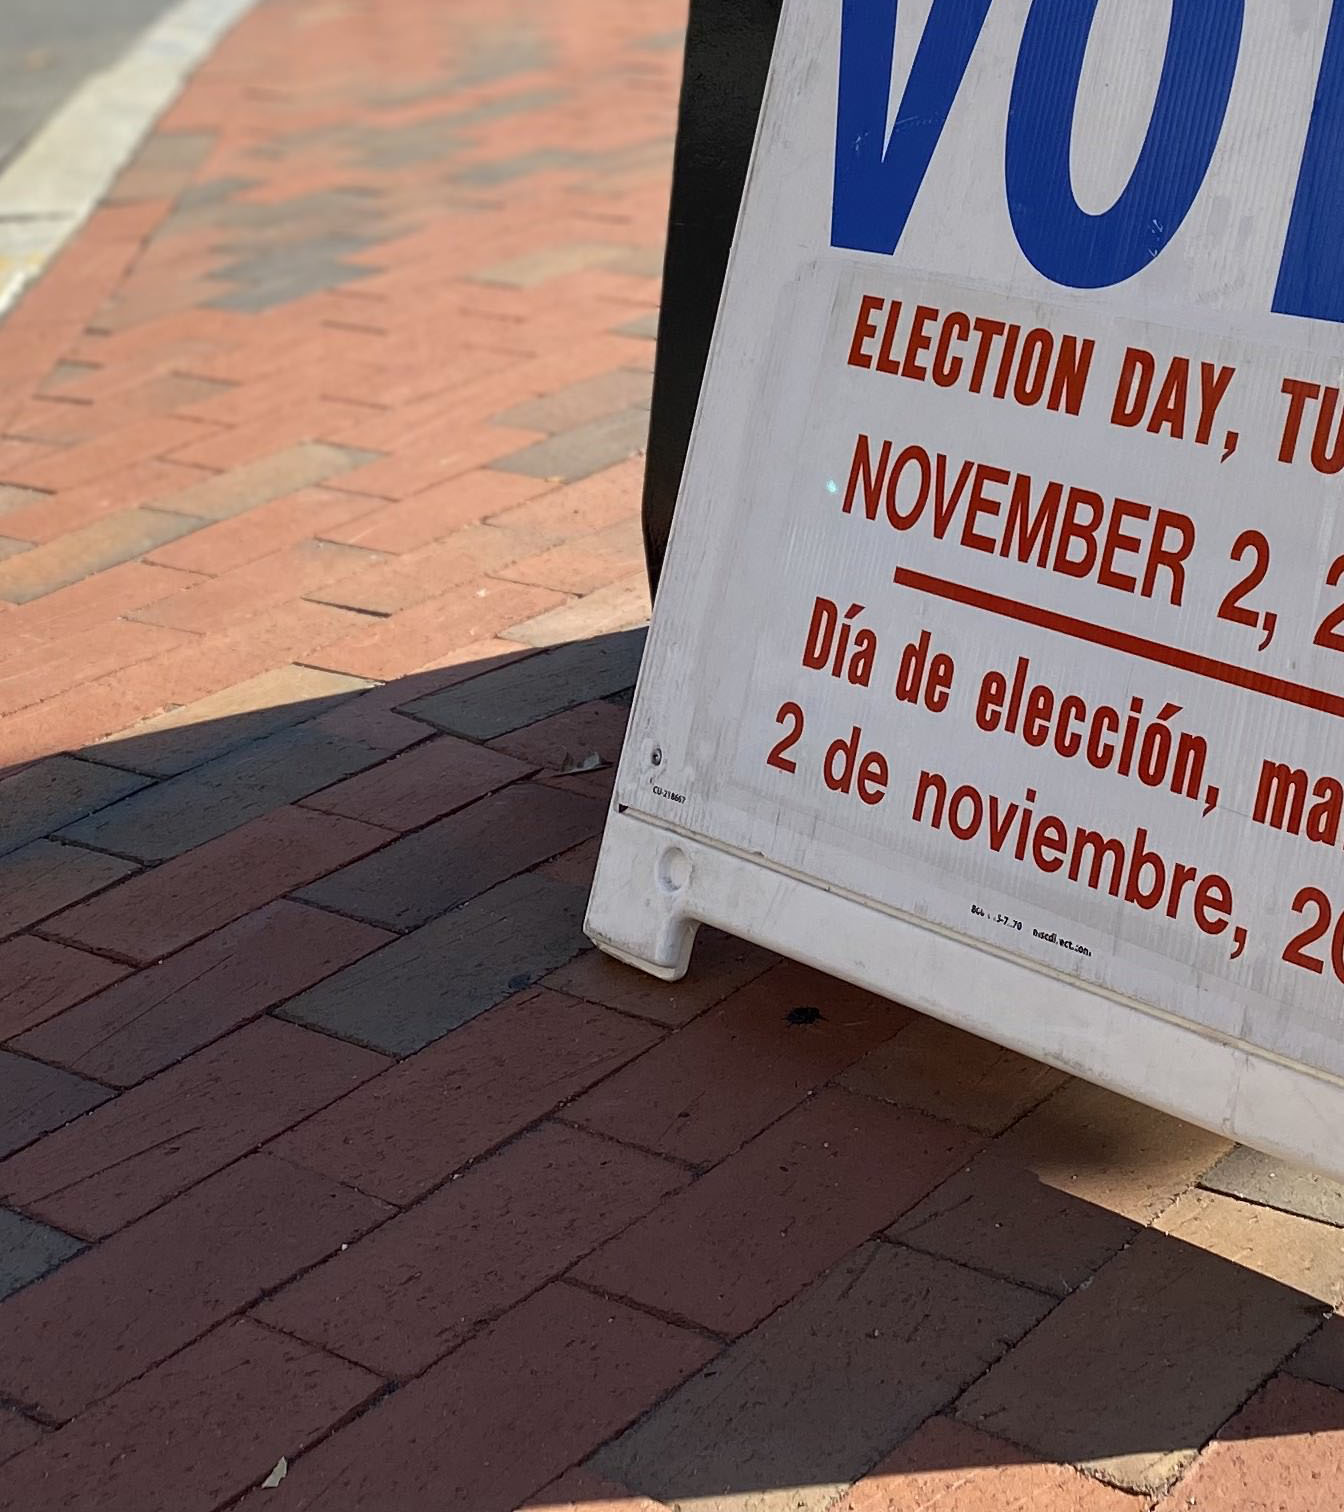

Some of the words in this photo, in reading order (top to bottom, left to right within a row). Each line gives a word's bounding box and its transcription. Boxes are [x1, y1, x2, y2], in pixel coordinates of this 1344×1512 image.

[847, 295, 1094, 417] ELECTION
[1110, 348, 1239, 464] DAY,
[841, 434, 1196, 607] NOVEMBER
[1217, 529, 1279, 653] 2,
[802, 597, 877, 689] Día
[895, 630, 954, 713] de
[976, 657, 1220, 817] elección,
[766, 701, 806, 774] 2
[822, 726, 889, 806] de
[912, 771, 1249, 961] noviembre,
